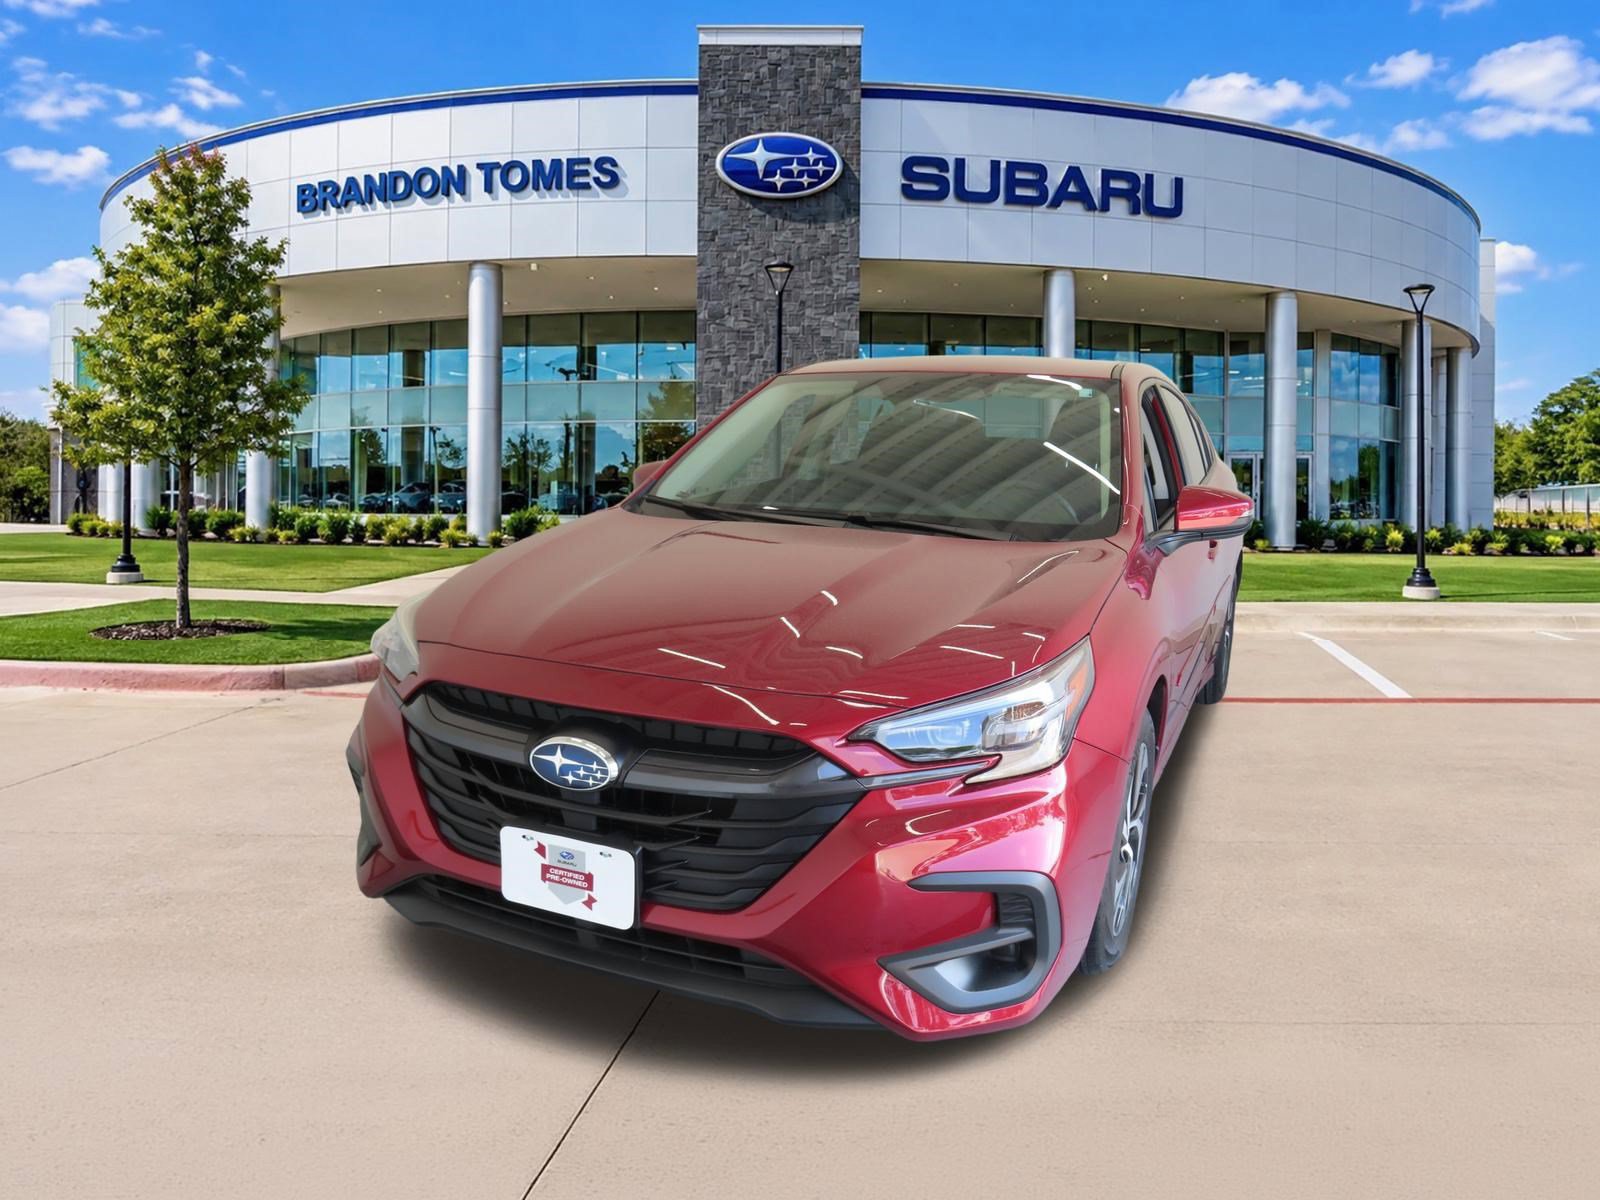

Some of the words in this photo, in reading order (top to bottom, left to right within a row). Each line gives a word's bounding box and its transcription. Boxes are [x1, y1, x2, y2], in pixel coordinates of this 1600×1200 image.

[296, 164, 467, 213] BRANDON
[476, 156, 620, 194] TOMES
[900, 155, 1184, 218] SUBARU
[545, 873, 588, 888] PRE-OWNED
[549, 867, 585, 881] CERTIFIED
